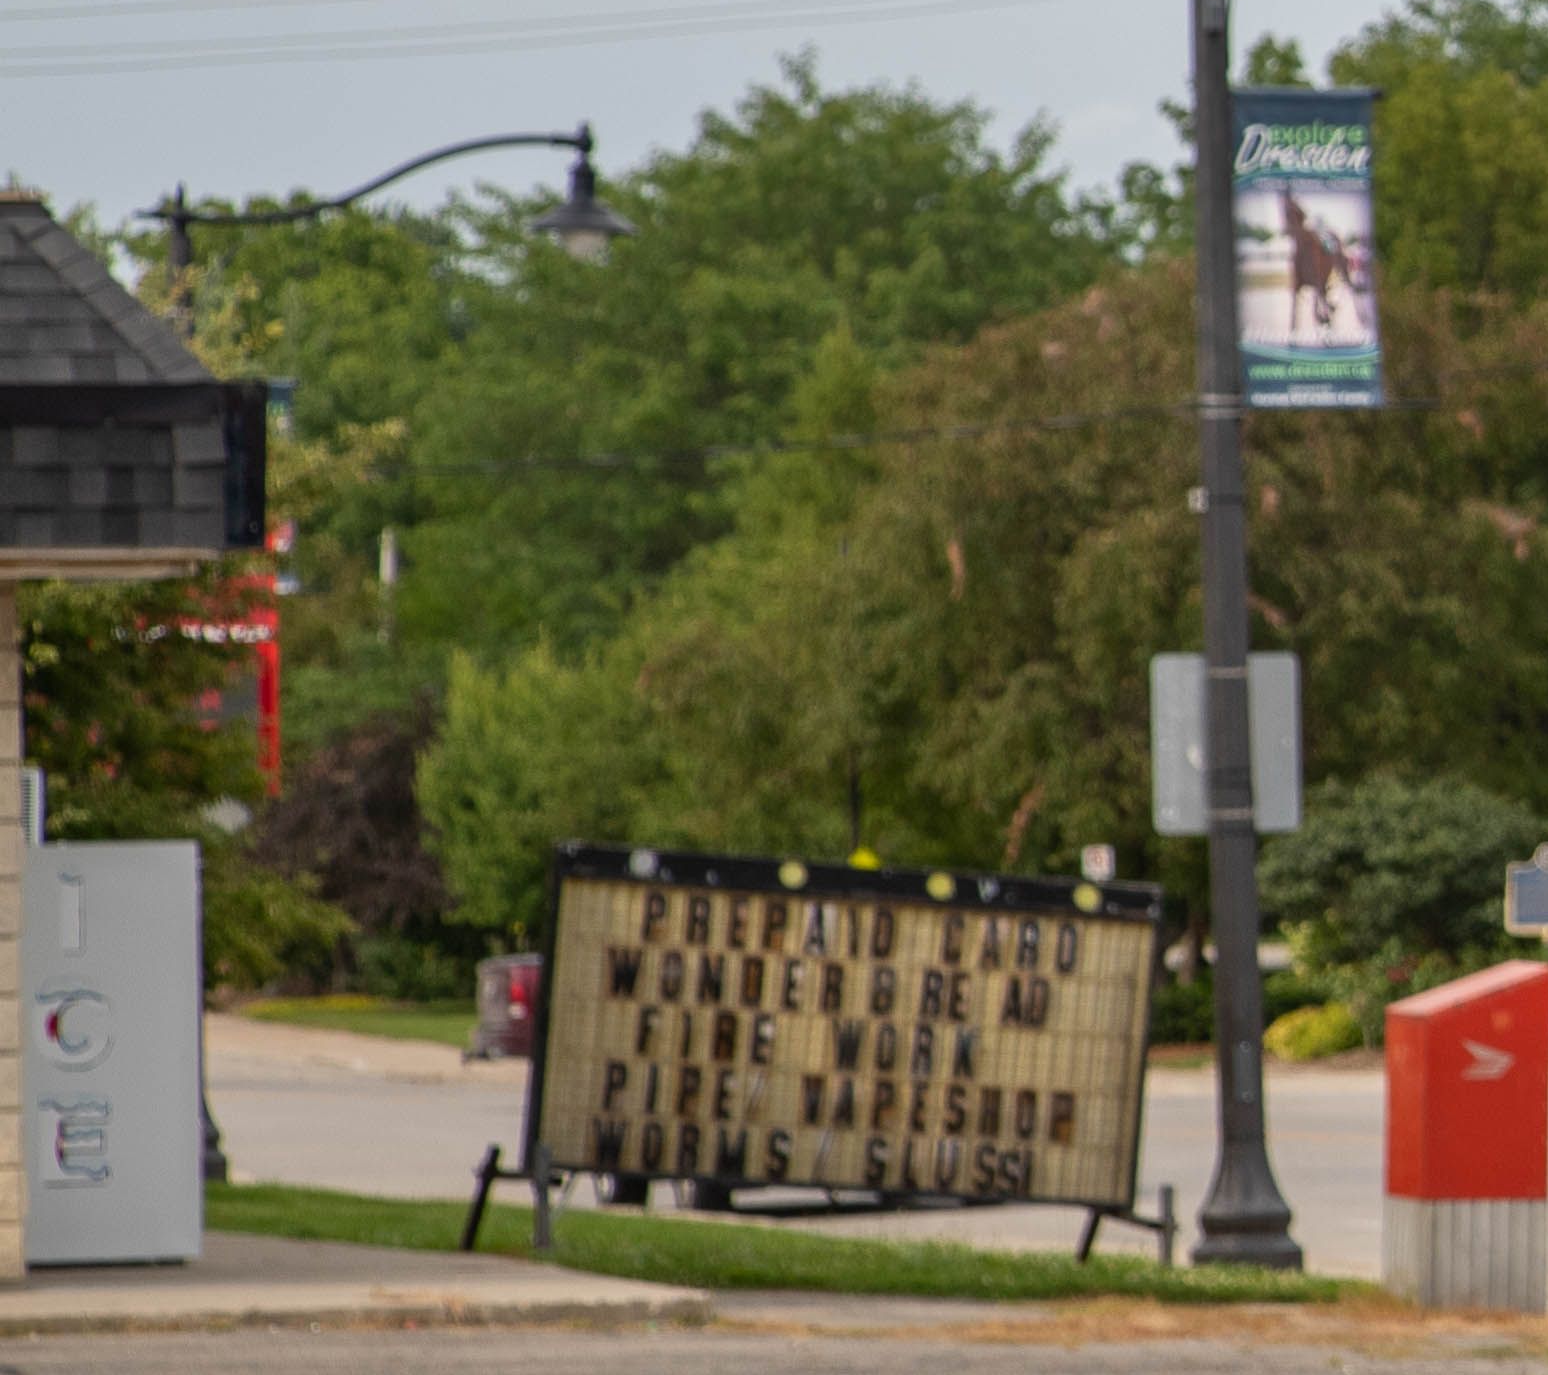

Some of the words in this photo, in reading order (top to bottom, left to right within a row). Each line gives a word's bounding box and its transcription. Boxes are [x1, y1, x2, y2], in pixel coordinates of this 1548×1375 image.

[1234, 124, 1372, 174] Dresden
[642, 888, 893, 959] PREPAID
[943, 911, 1078, 973] CARD
[608, 946, 844, 1015] WONDER
[637, 1005, 775, 1065] FIRE
[833, 1019, 980, 1078] WORK
[593, 1117, 792, 1182] WORMS
